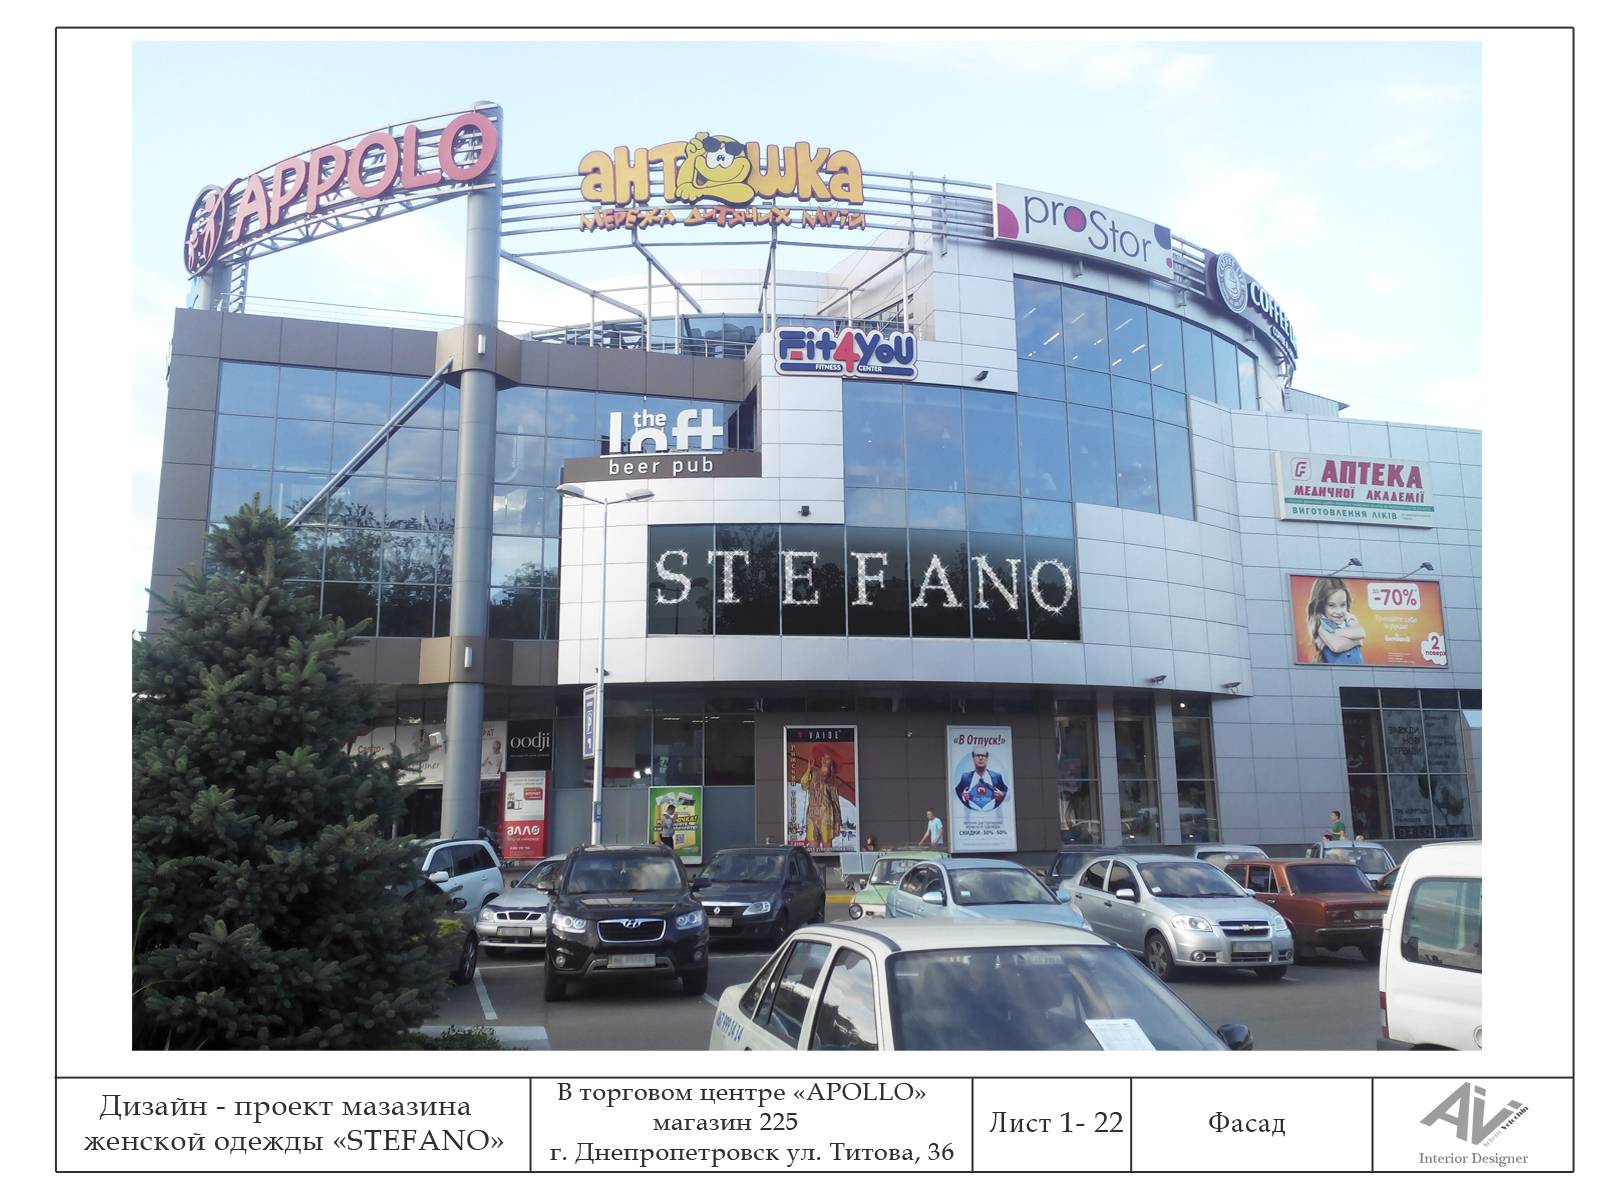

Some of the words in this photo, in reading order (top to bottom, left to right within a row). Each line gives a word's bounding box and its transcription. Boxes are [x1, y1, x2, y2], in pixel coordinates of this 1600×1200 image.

[231, 111, 498, 241] APPOLO
[1023, 195, 1152, 262] proStor
[815, 363, 842, 372] FITNESS
[858, 364, 883, 373] CENTER
[633, 409, 667, 428] the
[609, 458, 661, 476] beer
[672, 456, 715, 477] pub
[1320, 459, 1424, 489] АПТЕКА
[1293, 485, 1355, 499] МЕДИЧНОЇ
[1366, 490, 1425, 504] АКАДЕМІЇ
[1292, 506, 1368, 519] ВИГОТОВЛЕННЯ
[1371, 511, 1398, 520] ЛІКІВ
[653, 547, 1075, 616] STEFANO
[1431, 635, 1440, 650] 2
[510, 731, 550, 752] oodji
[808, 731, 839, 740] VAIDE
